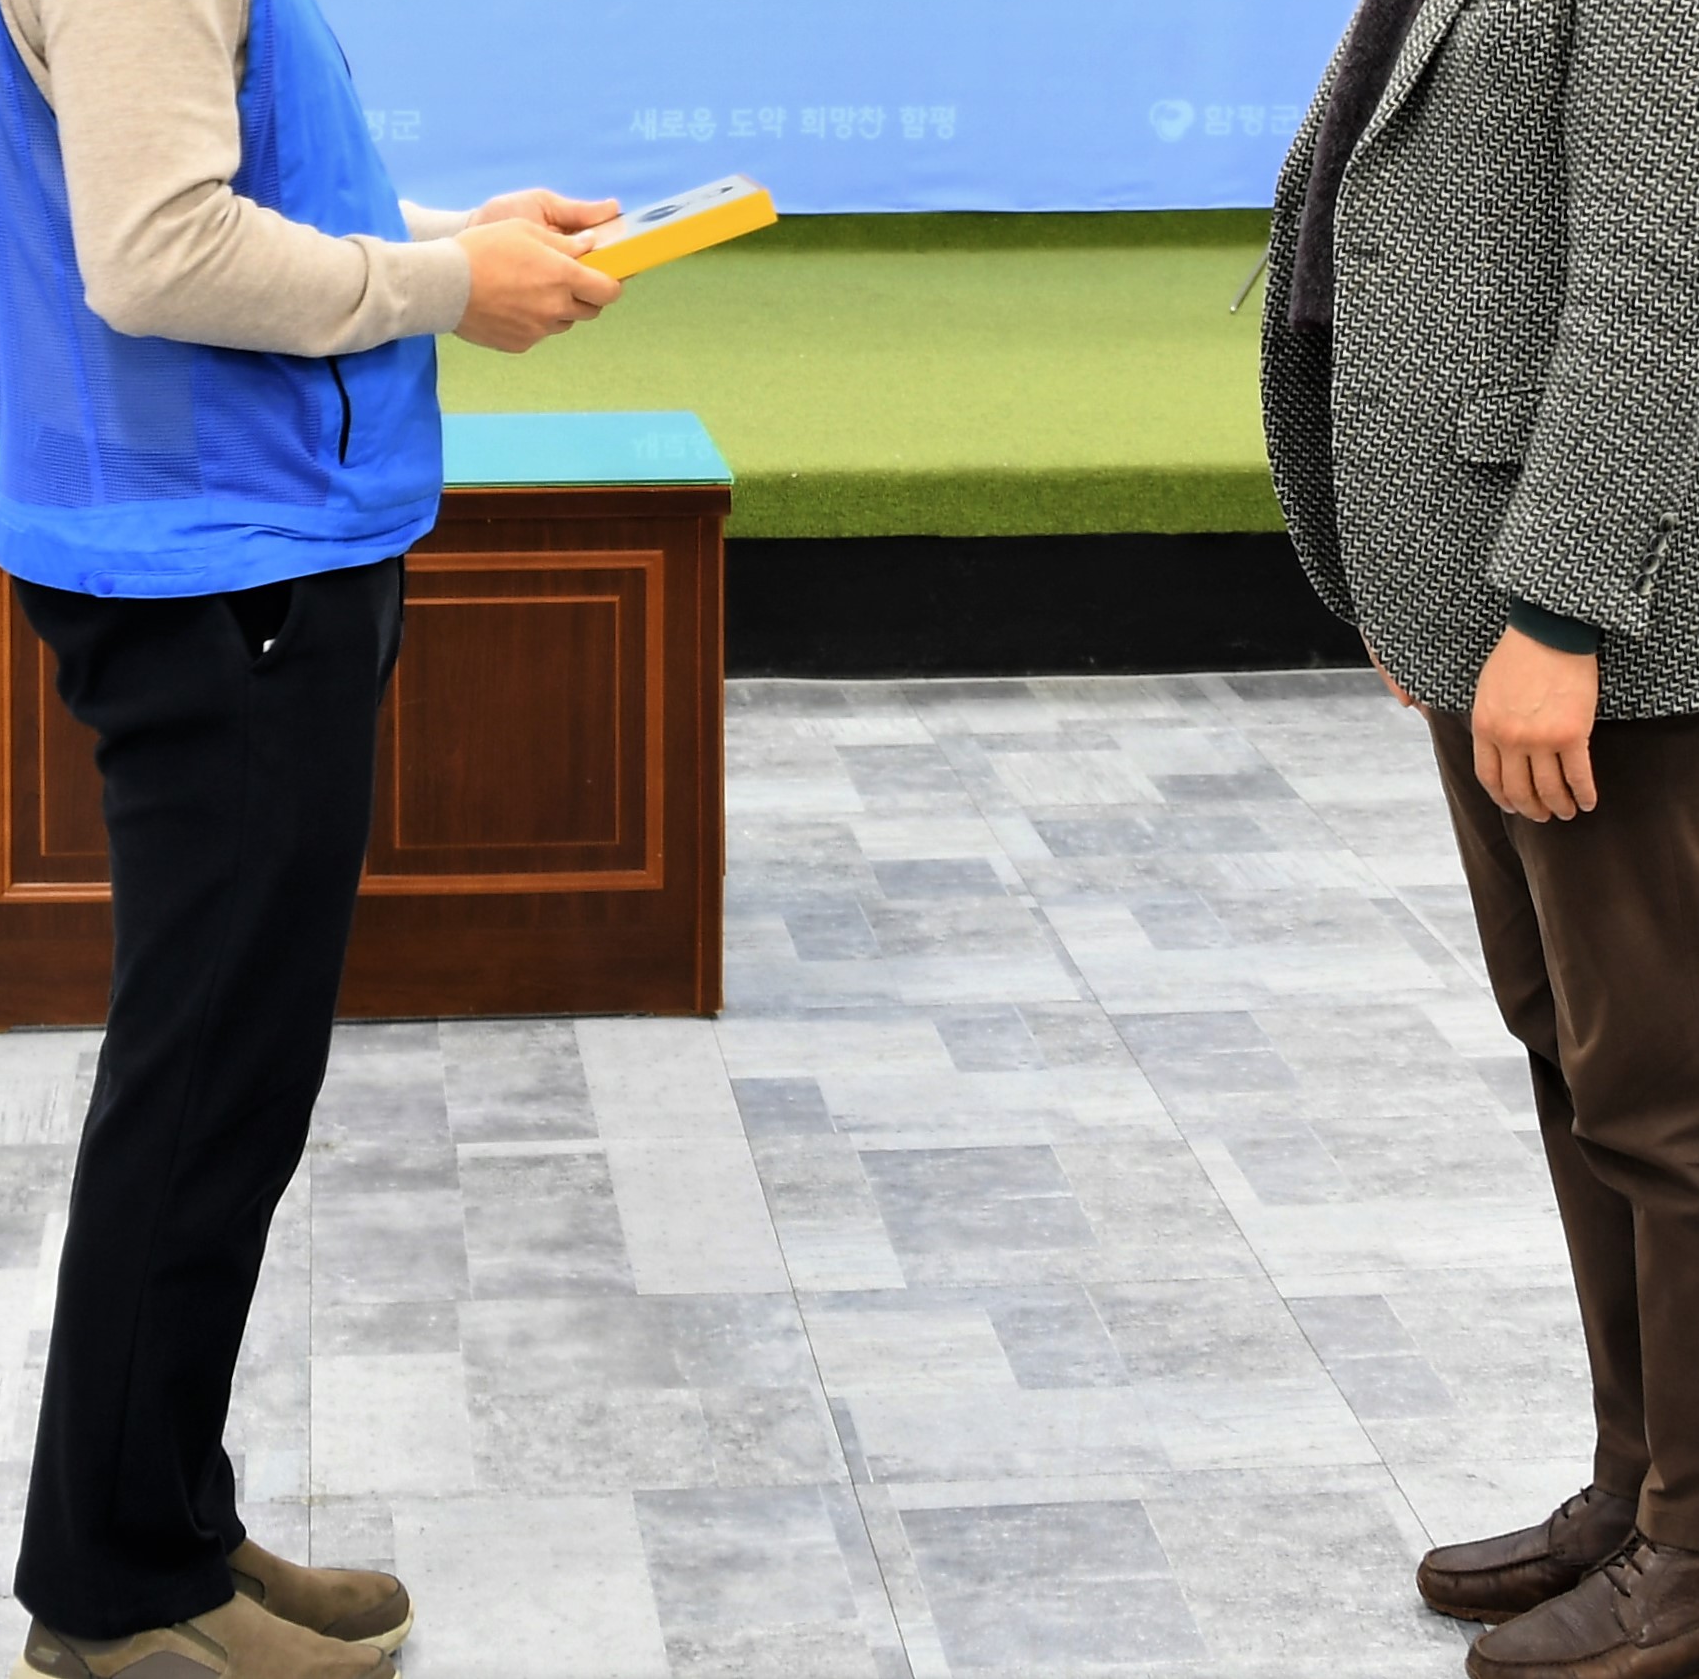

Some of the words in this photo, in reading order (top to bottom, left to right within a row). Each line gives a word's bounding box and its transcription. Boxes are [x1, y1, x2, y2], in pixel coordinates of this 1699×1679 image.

[628, 105, 717, 143] 새로운
[727, 105, 788, 140] 도약
[898, 105, 958, 141] 함평
